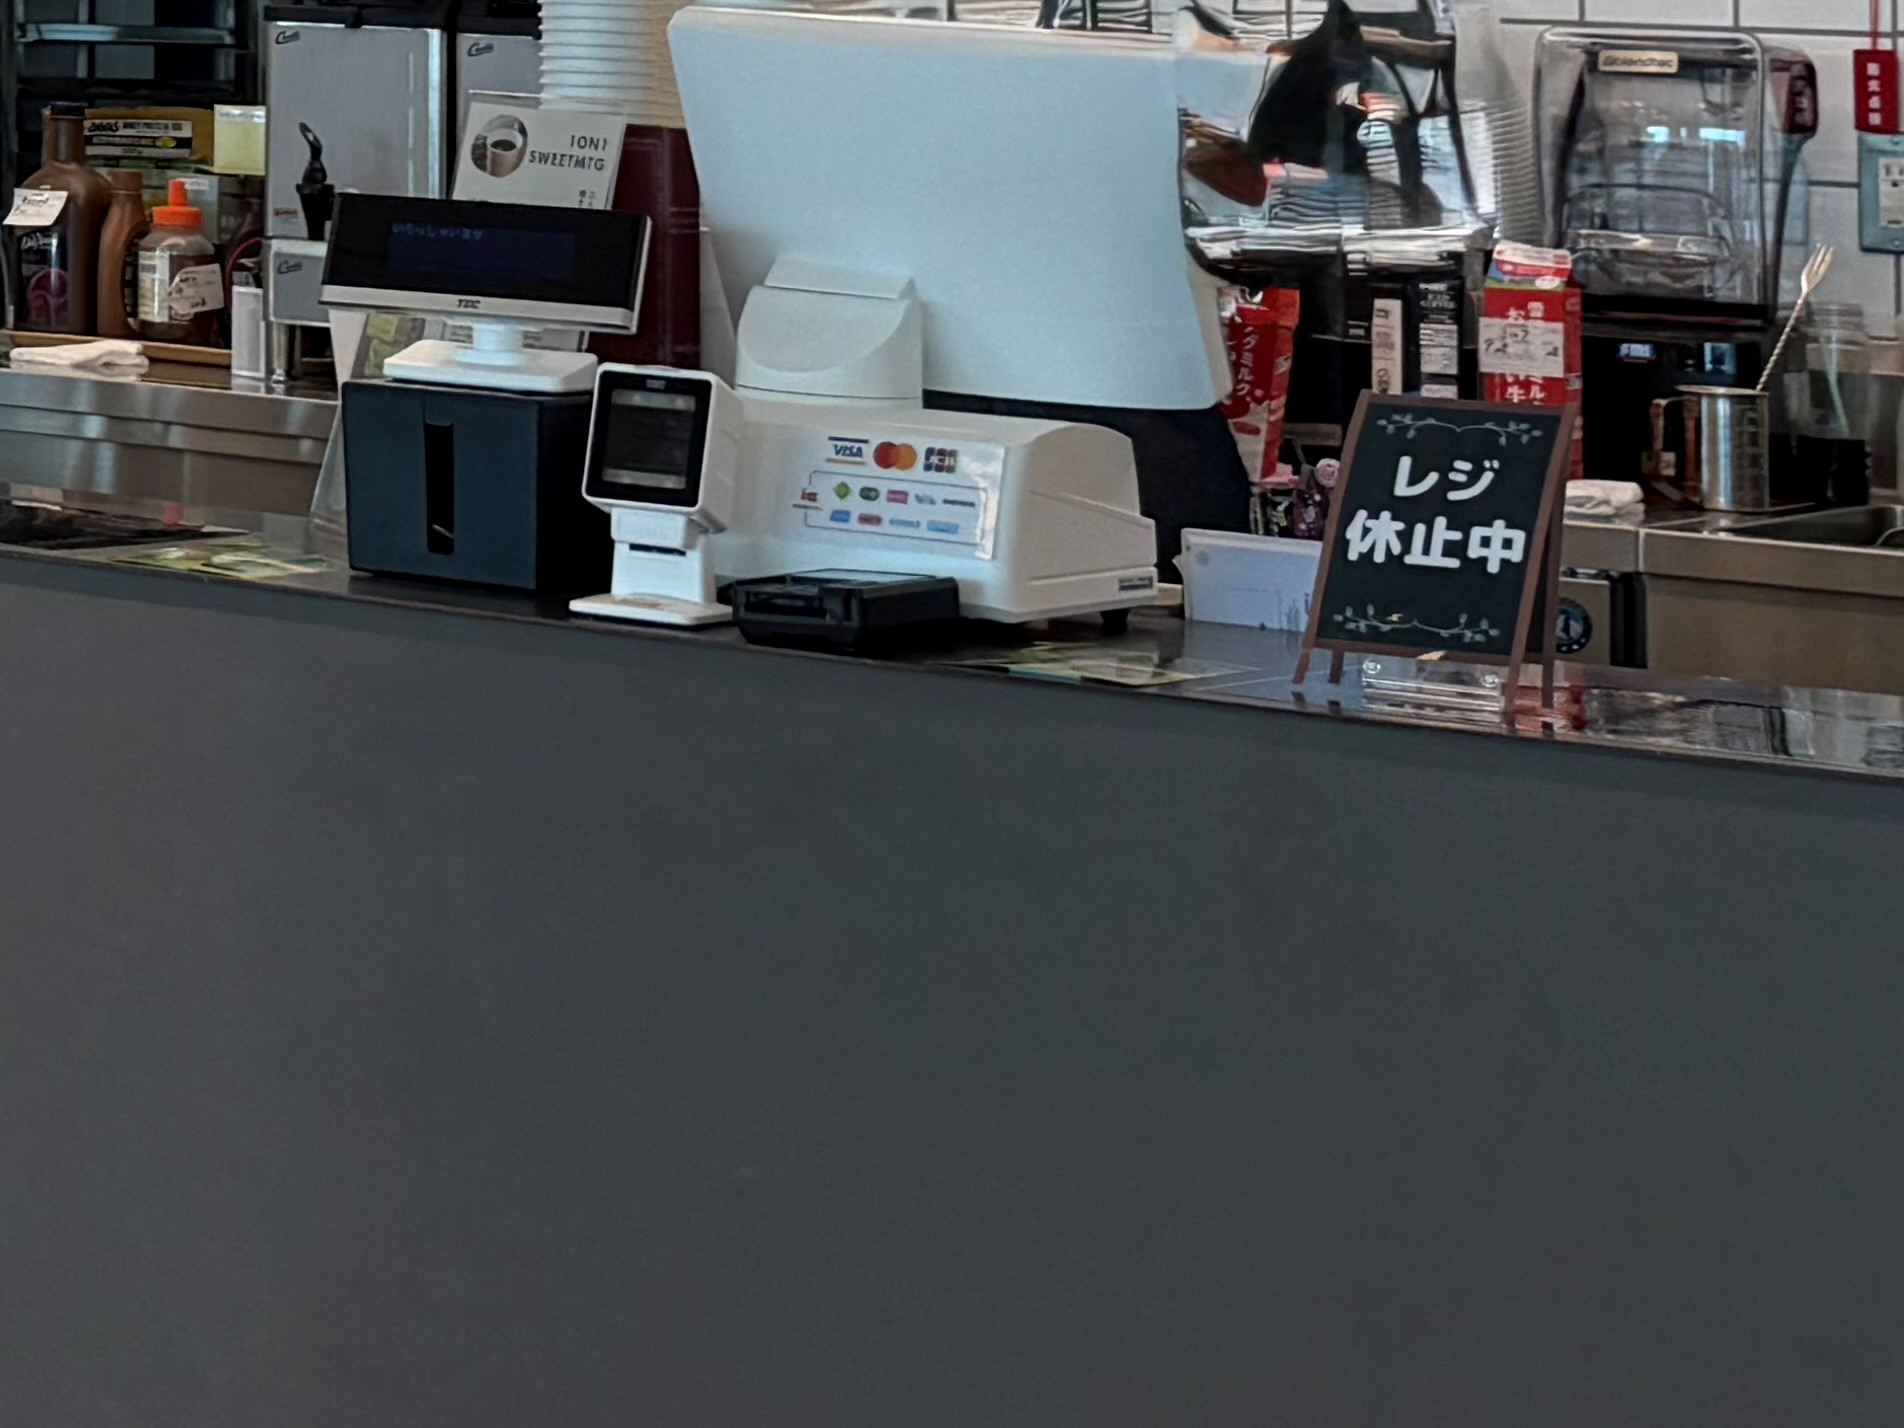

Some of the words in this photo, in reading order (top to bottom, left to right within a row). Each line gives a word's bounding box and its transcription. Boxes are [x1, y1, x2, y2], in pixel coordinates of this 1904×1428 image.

[833, 444, 864, 458] VISA
[1393, 454, 1500, 502] レジ
[1344, 509, 1527, 575] 休止中
